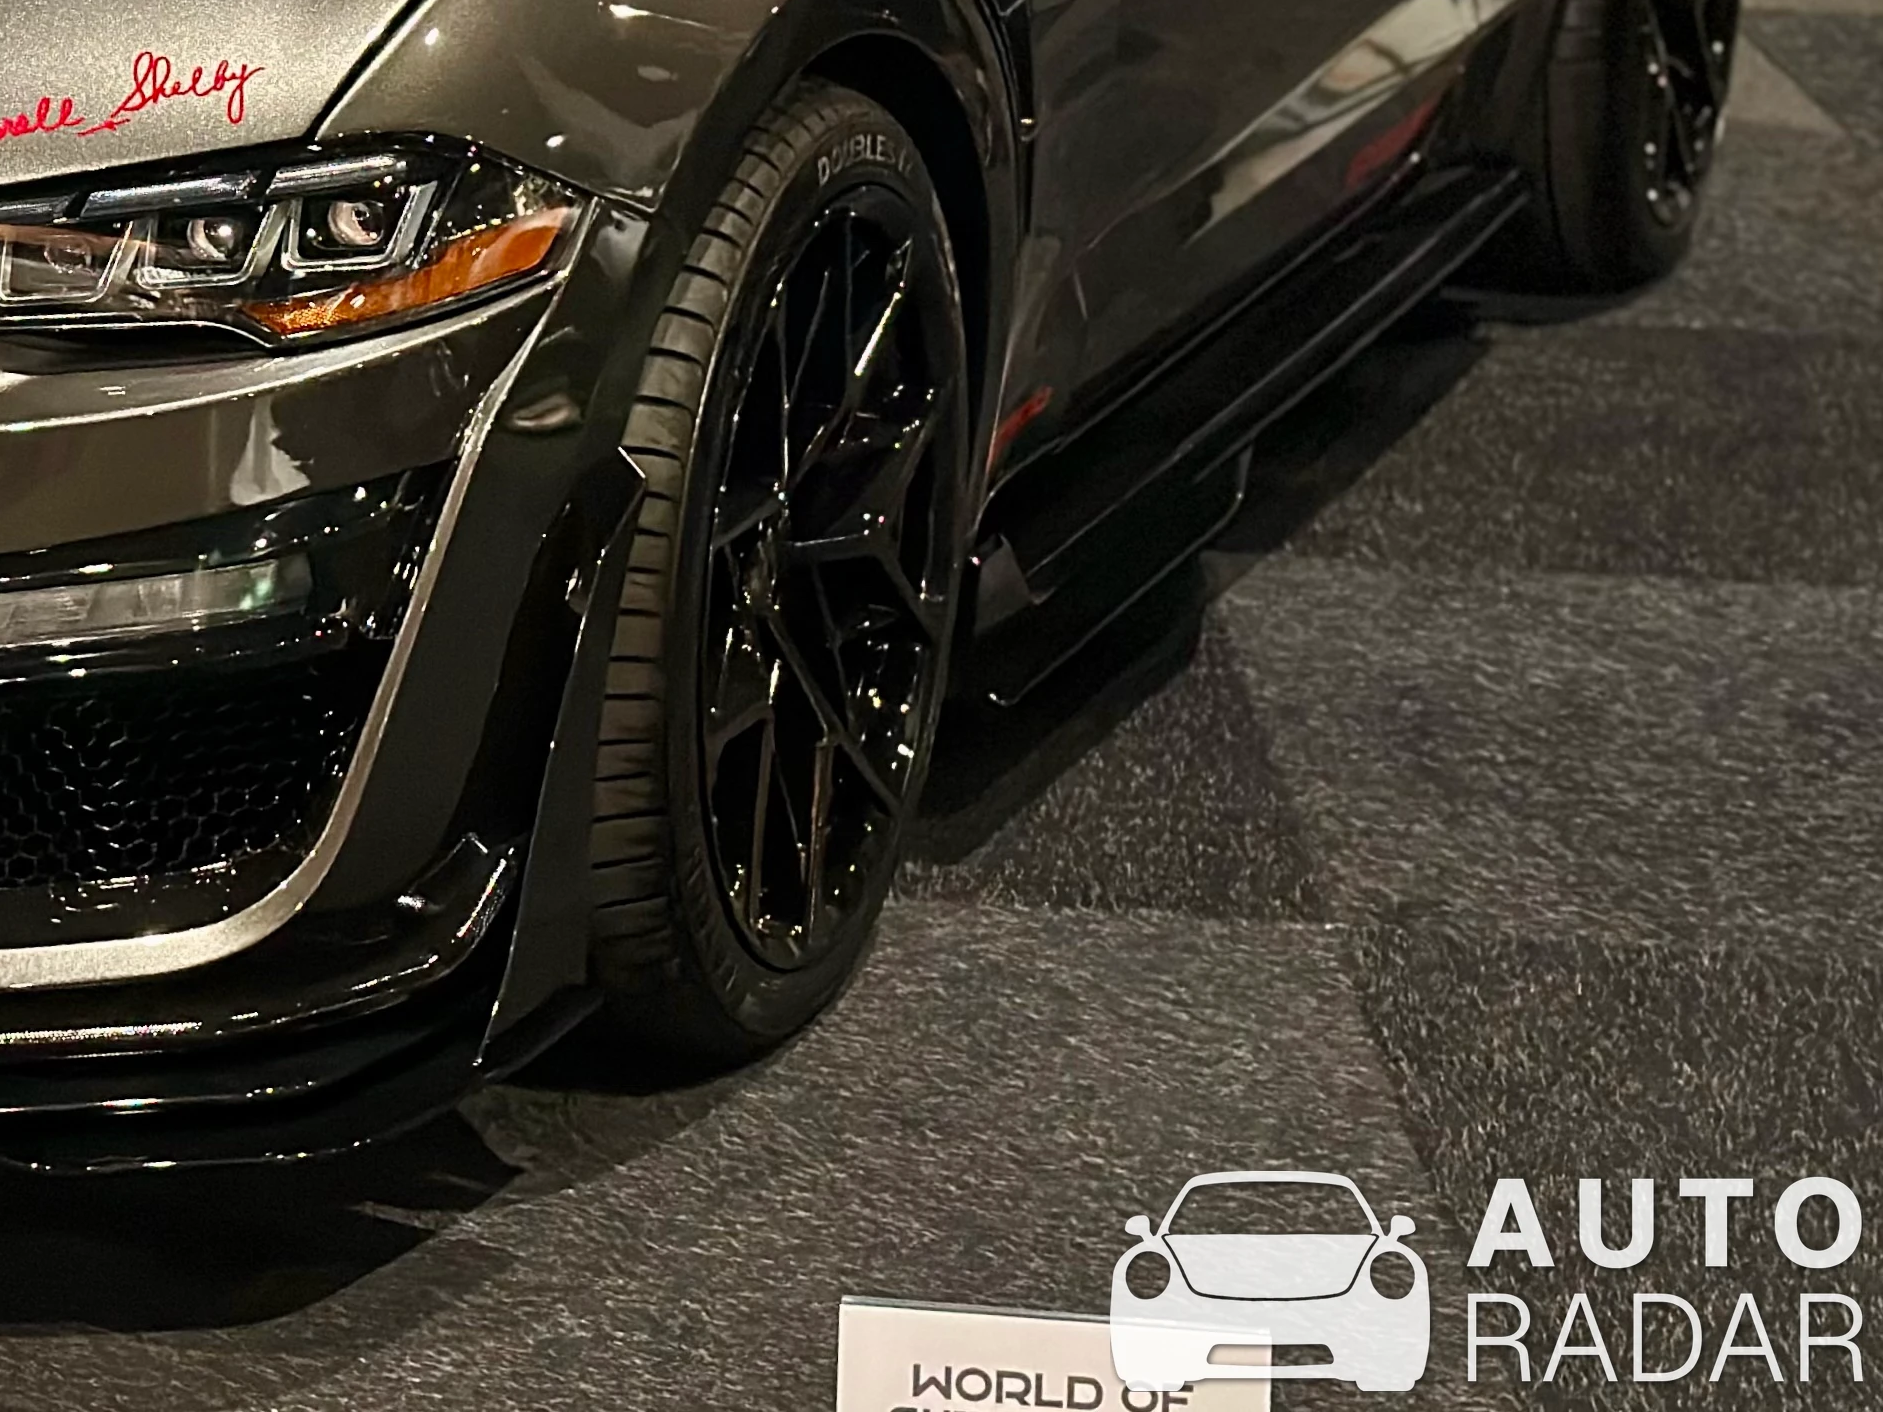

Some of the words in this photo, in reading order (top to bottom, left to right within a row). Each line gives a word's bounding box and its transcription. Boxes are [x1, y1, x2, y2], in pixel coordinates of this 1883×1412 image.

[109, 51, 266, 125] Shelby
[911, 1362, 1104, 1411] WORLD
[1120, 1380, 1195, 1412] OF
